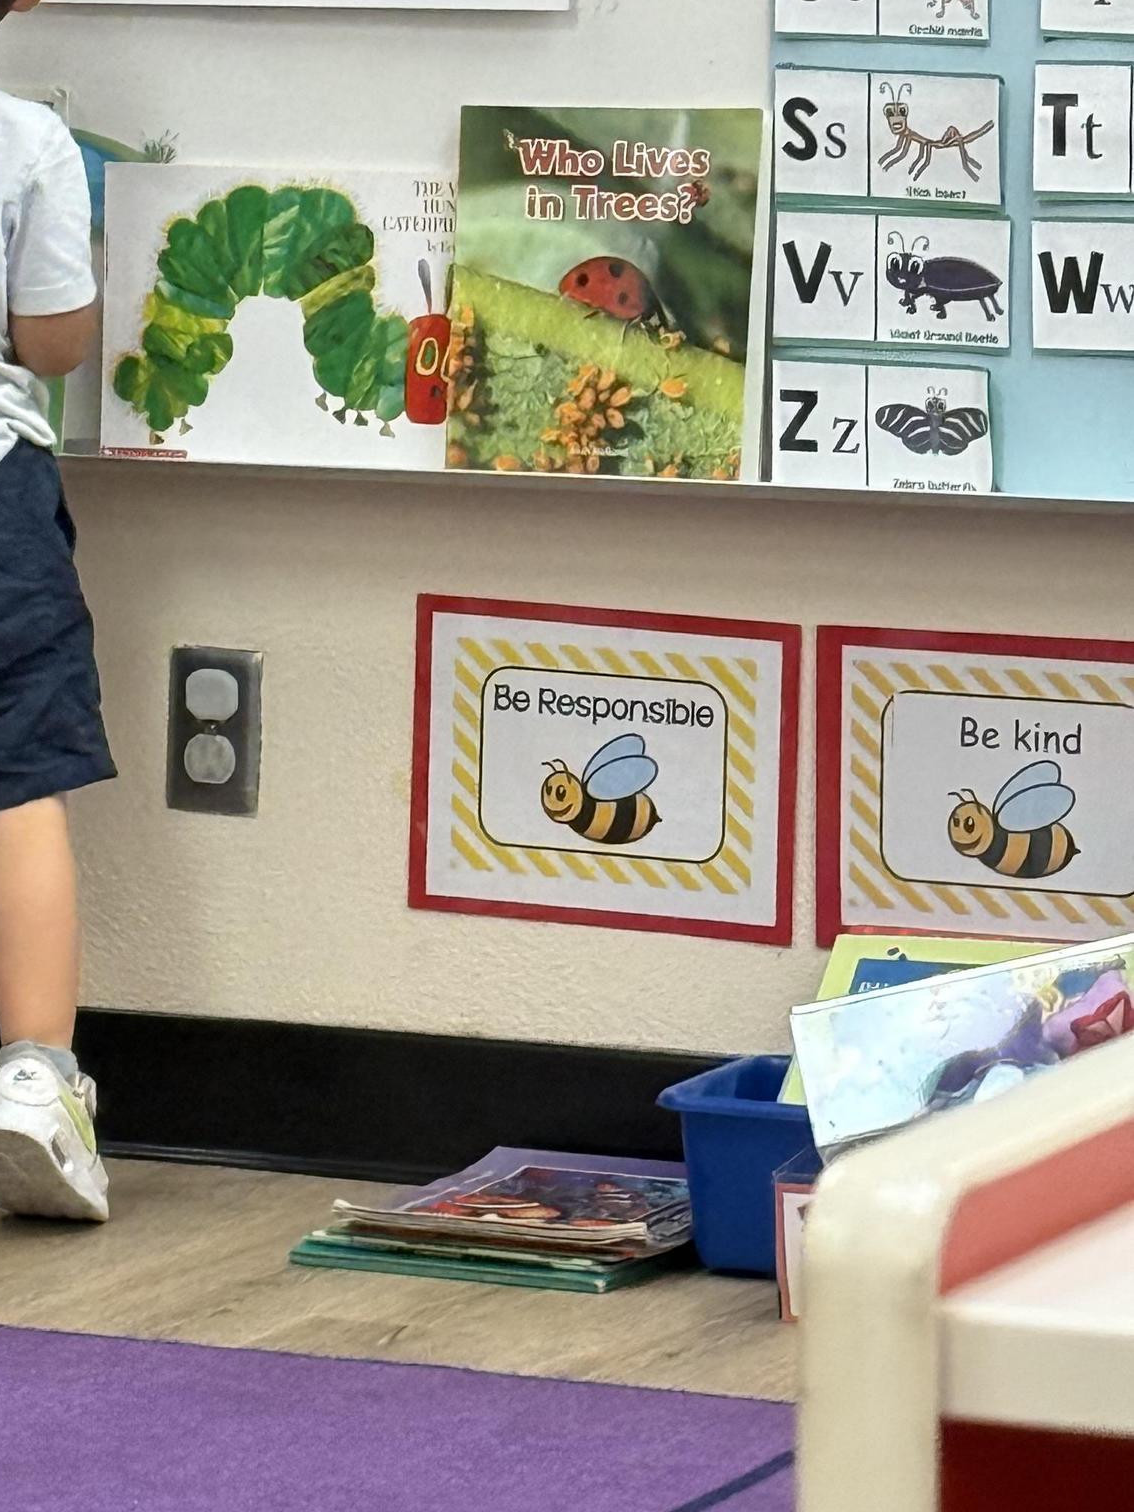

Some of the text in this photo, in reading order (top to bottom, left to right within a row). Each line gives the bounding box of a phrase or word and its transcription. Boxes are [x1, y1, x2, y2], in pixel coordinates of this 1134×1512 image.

[519, 138, 711, 178] Who Lives
[525, 183, 698, 225] in Trees?
[492, 683, 715, 729] Be Responsible
[960, 715, 1083, 755] Be kind
